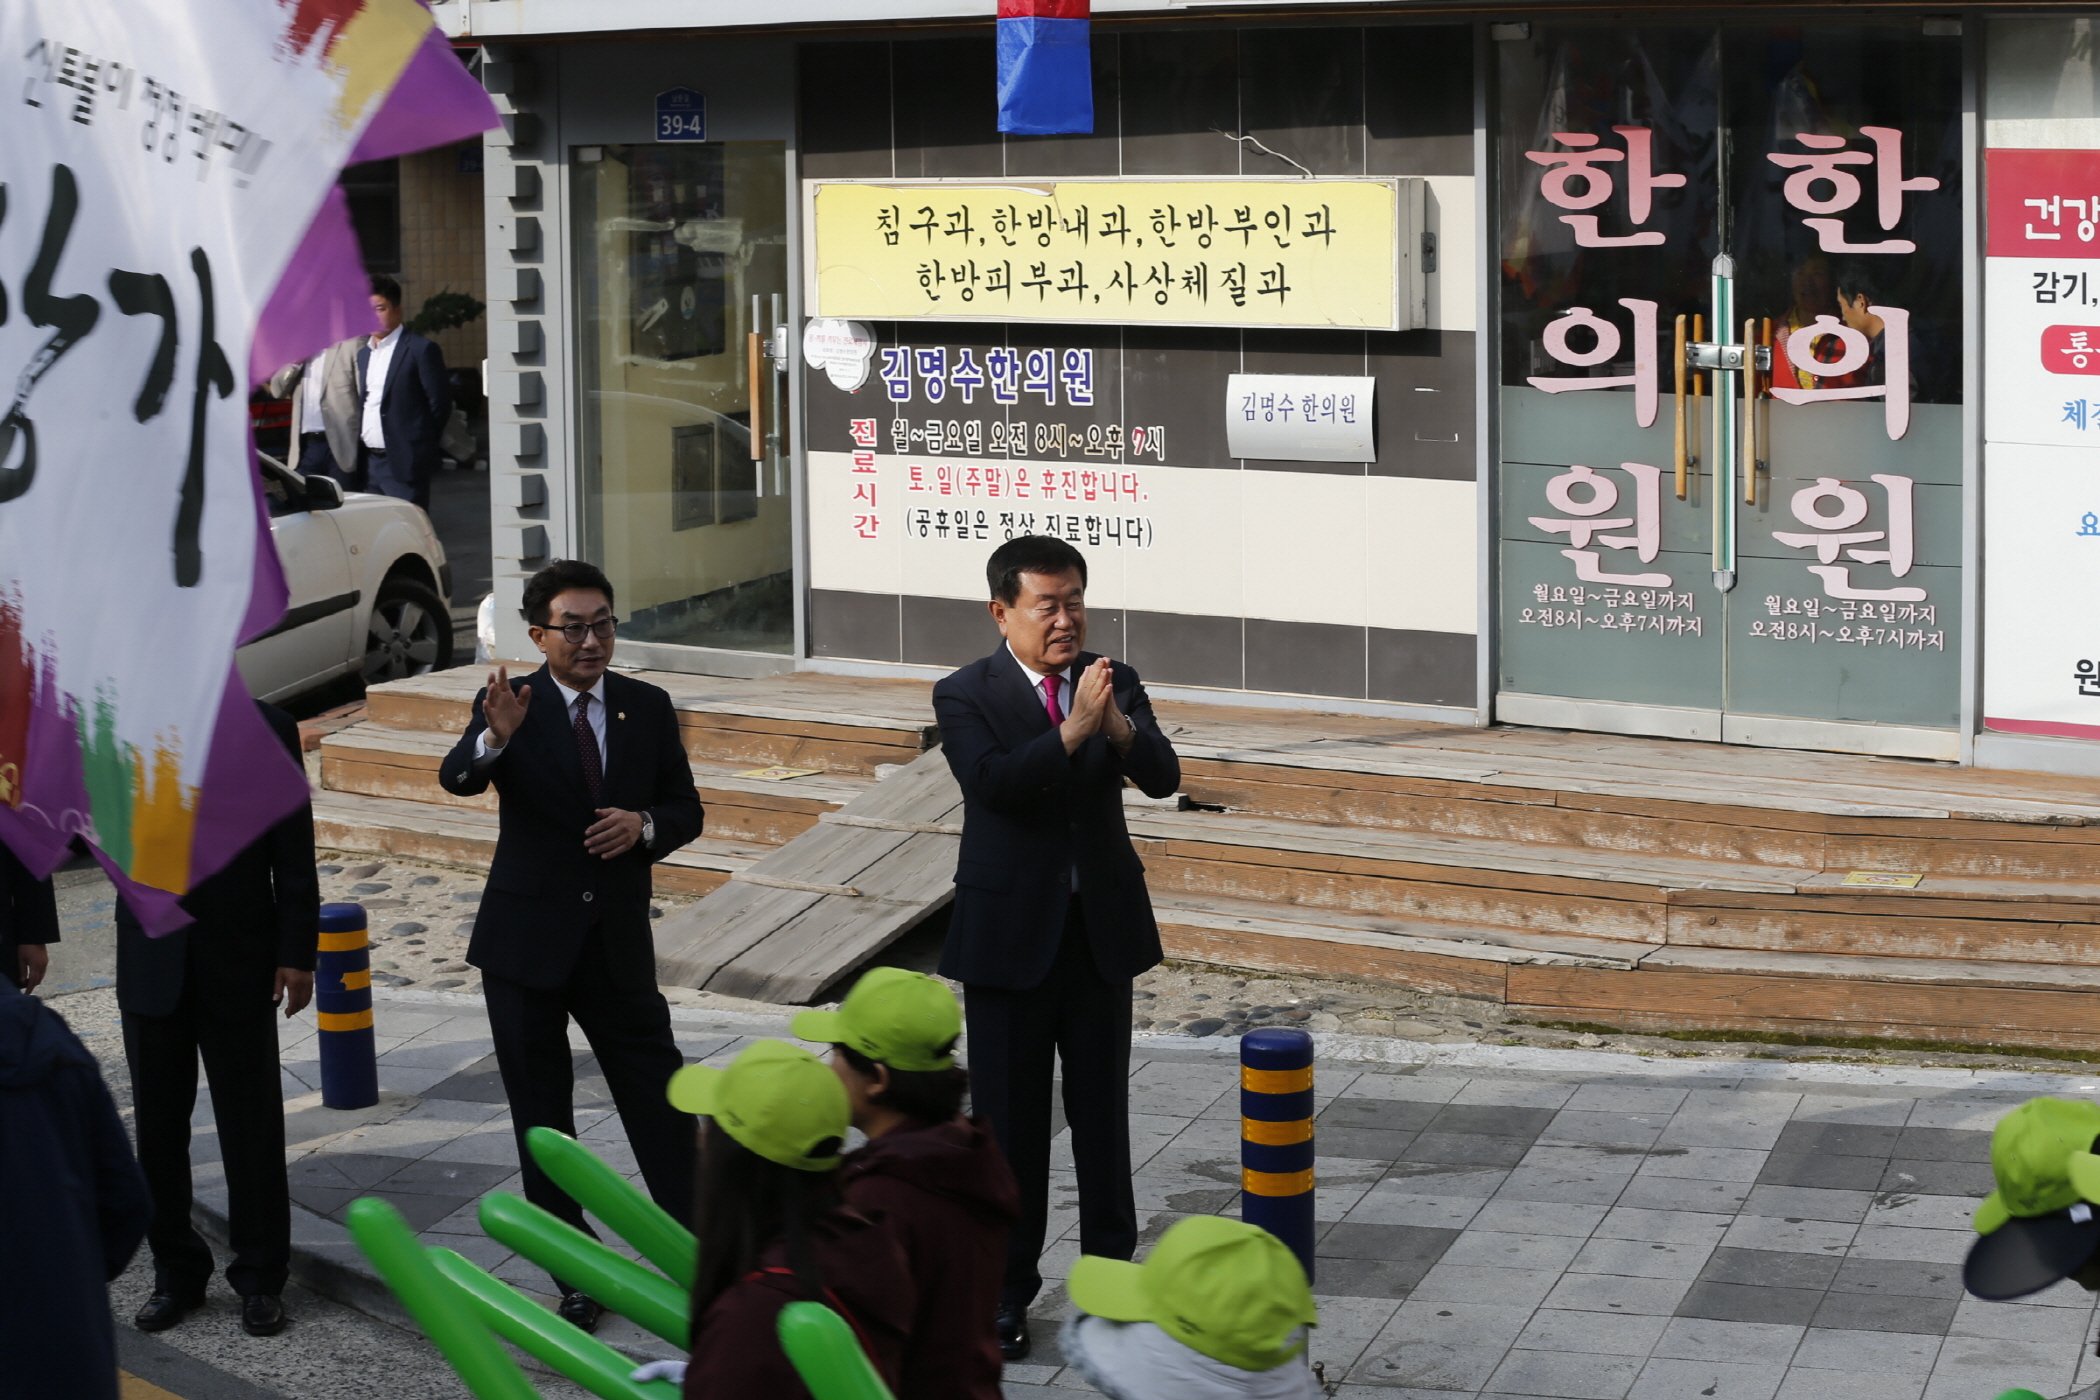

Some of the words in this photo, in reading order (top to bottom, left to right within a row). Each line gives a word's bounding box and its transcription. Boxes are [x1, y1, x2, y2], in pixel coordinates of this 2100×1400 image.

[661, 115, 701, 135] 39-4
[2033, 271, 2098, 307] 감기,
[1525, 125, 1687, 588] 한의원
[1766, 126, 1940, 601] 한의원
[2060, 331, 2100, 368] 통
[881, 347, 1094, 405] 김명수한의원
[1242, 392, 1295, 423] 김명수
[1301, 393, 1356, 424] 한의원
[892, 419, 982, 454] 월~금요일
[989, 420, 1028, 455] 오전
[1035, 422, 1125, 459] 8시~오후
[1132, 426, 1165, 460] 7시
[850, 418, 881, 539] 진료시간
[907, 465, 1031, 497] 토.일(주말)은
[1040, 469, 1149, 503] 휴진합니다.
[905, 507, 989, 540] (공휴일은
[1532, 583, 1696, 613] 월요일~금요일까지
[1763, 595, 1938, 627] 월요일~금요일까지
[1518, 608, 1704, 638] 오전8시~오후7시까지
[1748, 620, 1946, 651] 오전8시~오후7시까지
